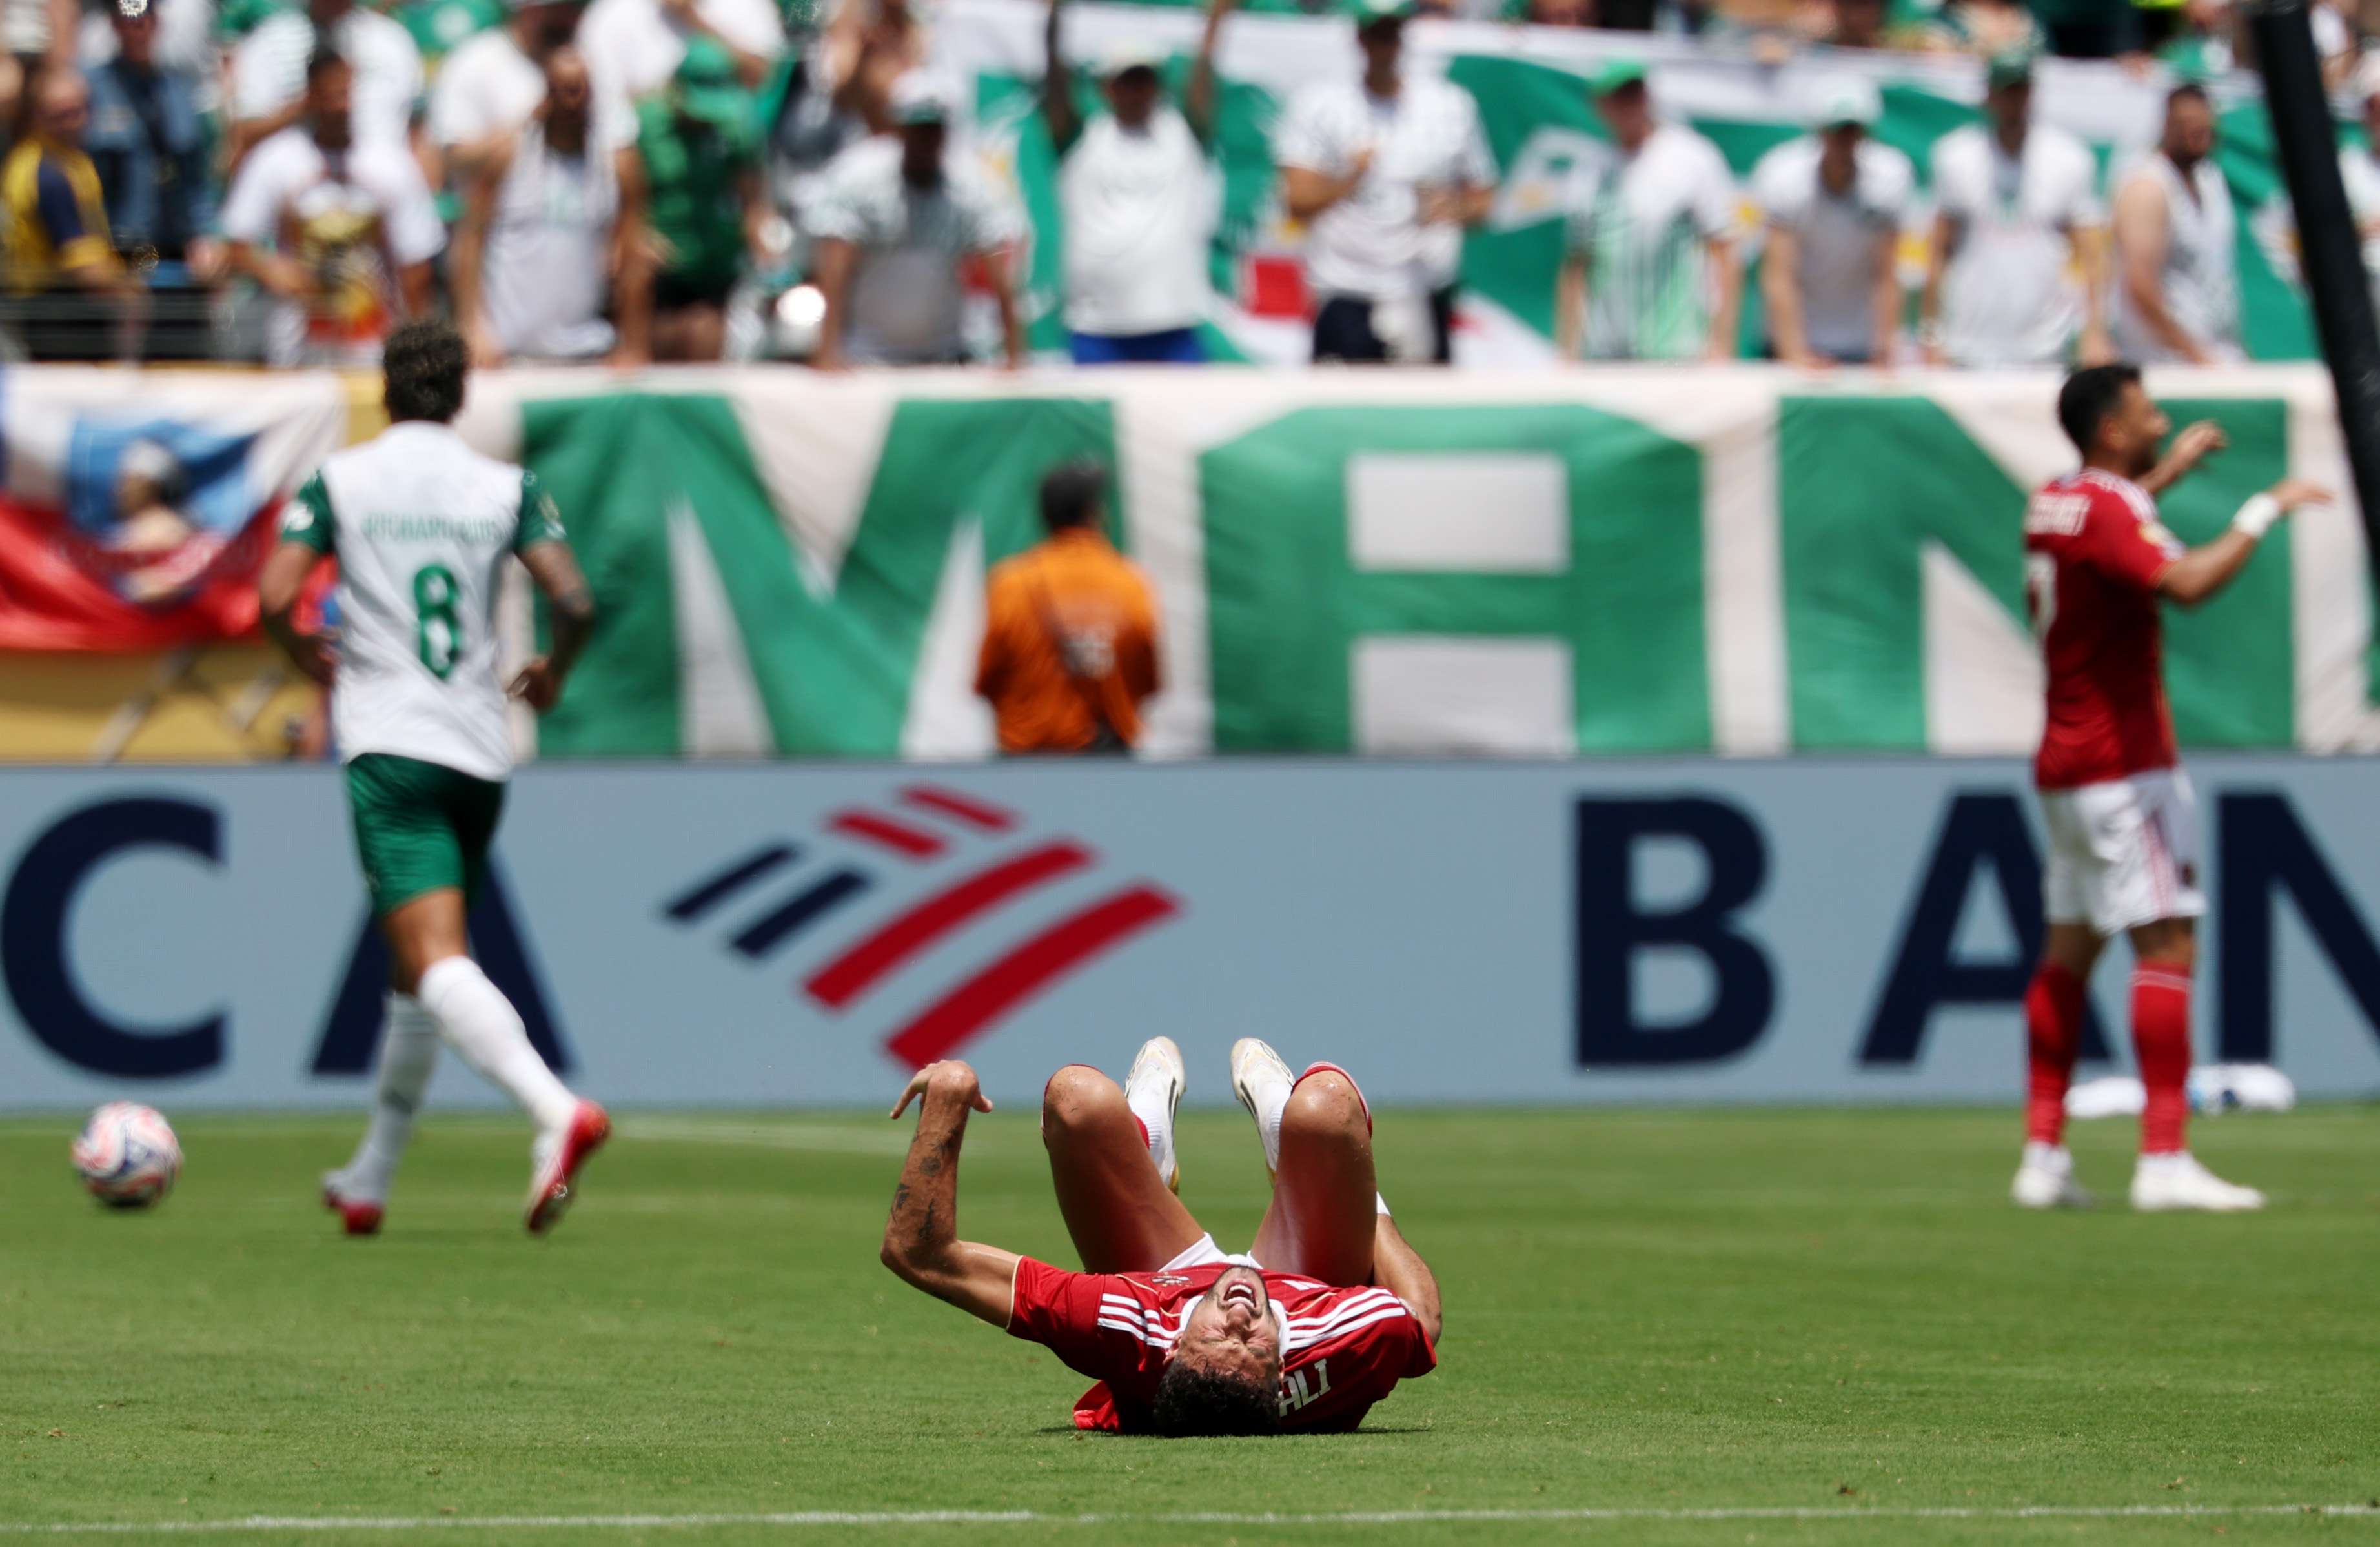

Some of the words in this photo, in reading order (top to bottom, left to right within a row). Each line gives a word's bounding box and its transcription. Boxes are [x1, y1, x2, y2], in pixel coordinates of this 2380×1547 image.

[412, 563, 462, 682] 8
[522, 392, 2380, 753] MAN
[1, 794, 573, 1077] CA
[1573, 793, 2380, 1069] BAN
[1277, 1357, 1332, 1417] ALI
